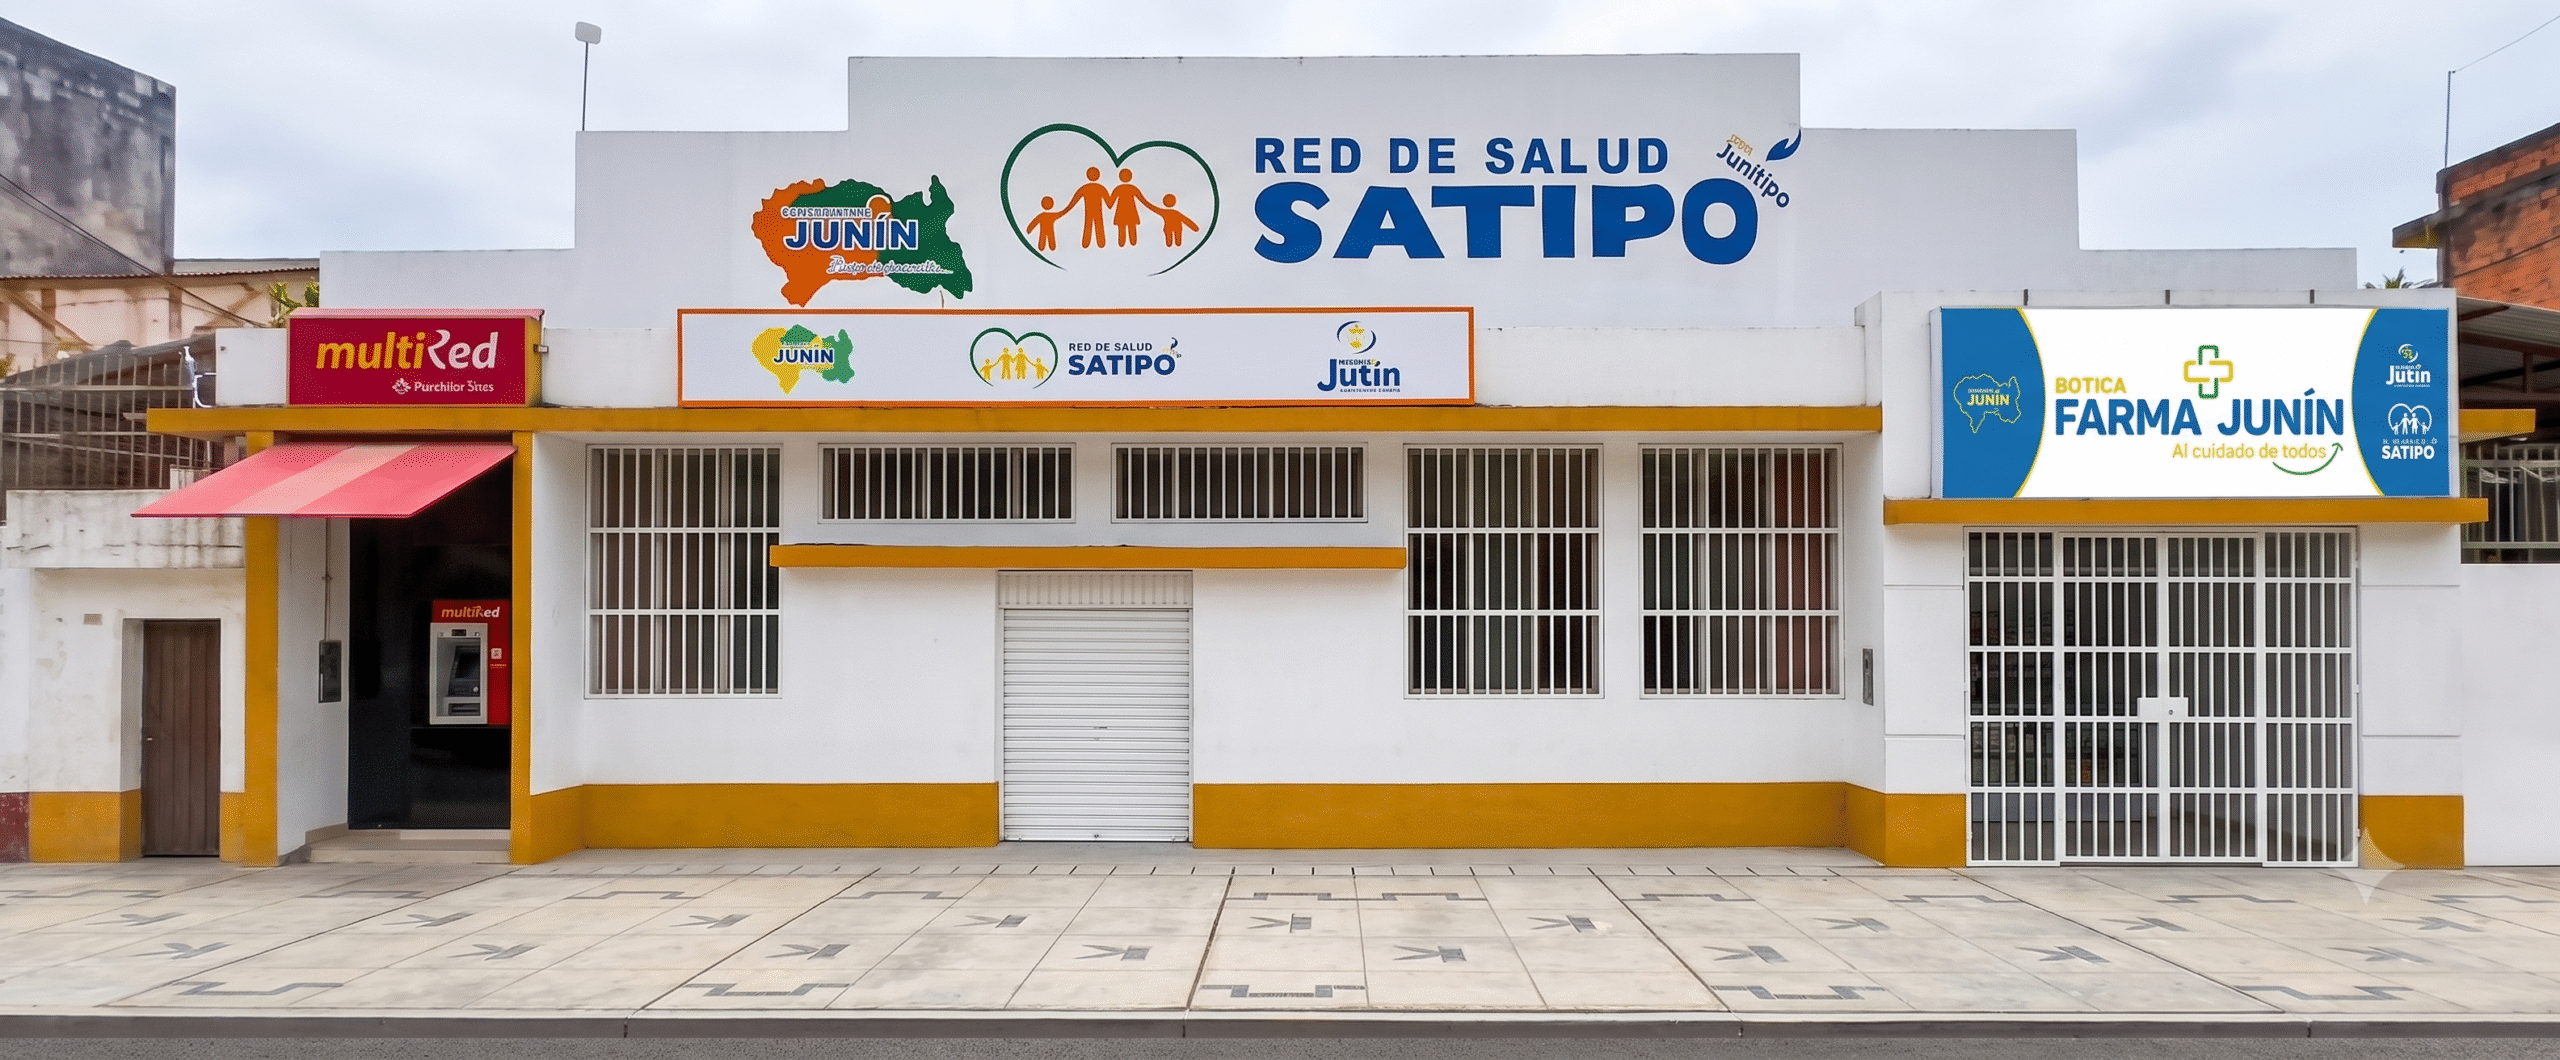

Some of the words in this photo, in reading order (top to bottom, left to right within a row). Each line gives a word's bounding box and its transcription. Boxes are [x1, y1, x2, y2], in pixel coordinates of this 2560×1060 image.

[1255, 137, 1361, 173] RED
[1389, 137, 1455, 173] DE
[1485, 137, 1669, 174] SALUD
[1716, 142, 1790, 208] Junitipo
[784, 213, 918, 249] JUNÍN
[1254, 177, 1758, 264] SATIPO
[315, 329, 499, 370] multiRed
[773, 349, 834, 363] JUNIN
[1069, 342, 1092, 352] RED
[1095, 342, 1110, 352] DE
[1114, 342, 1153, 352] SALUD
[1068, 354, 1176, 376] SATIPO
[1317, 358, 1401, 392] Jutín
[2055, 377, 2127, 393] BOTICA
[2055, 398, 2202, 436] FARMA
[2217, 387, 2344, 436] JUNÍN
[2172, 442, 2188, 458] Al
[2192, 442, 2255, 458] cuidado
[2259, 442, 2279, 458] de
[2282, 442, 2327, 458] todos
[2381, 445, 2435, 460] SATIPO
